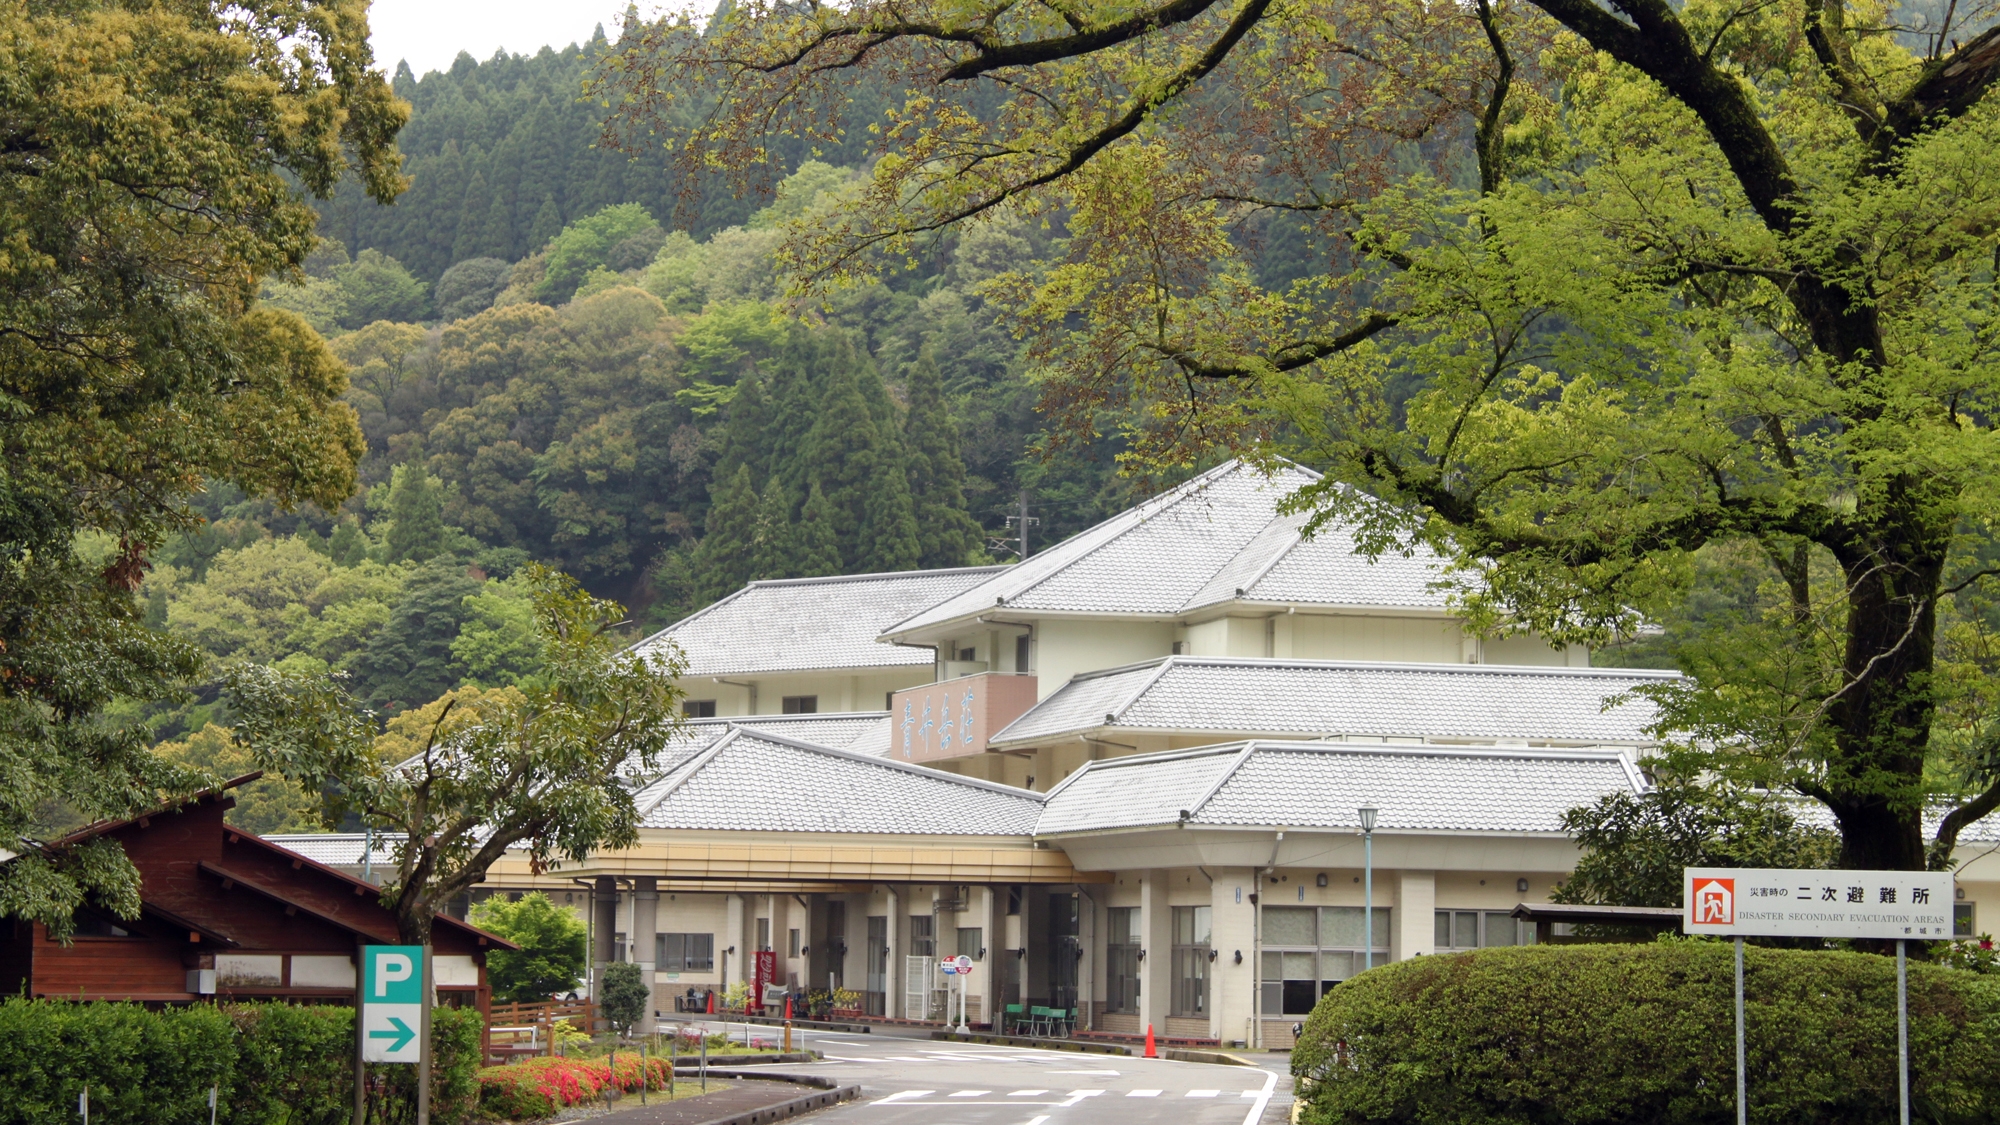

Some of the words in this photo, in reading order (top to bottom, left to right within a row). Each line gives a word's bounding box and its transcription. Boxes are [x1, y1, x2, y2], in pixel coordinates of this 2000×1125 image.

[900, 686, 974, 758] 青井岳荘
[1749, 887, 1788, 898] 災害時の
[1797, 886, 1930, 905] 二次避難所
[1738, 911, 1784, 921] DISASTER
[1788, 912, 1846, 922] SECONDARY
[1849, 914, 1910, 923] EVACUATION
[1913, 915, 1945, 924] AREAS
[374, 953, 413, 997] P
